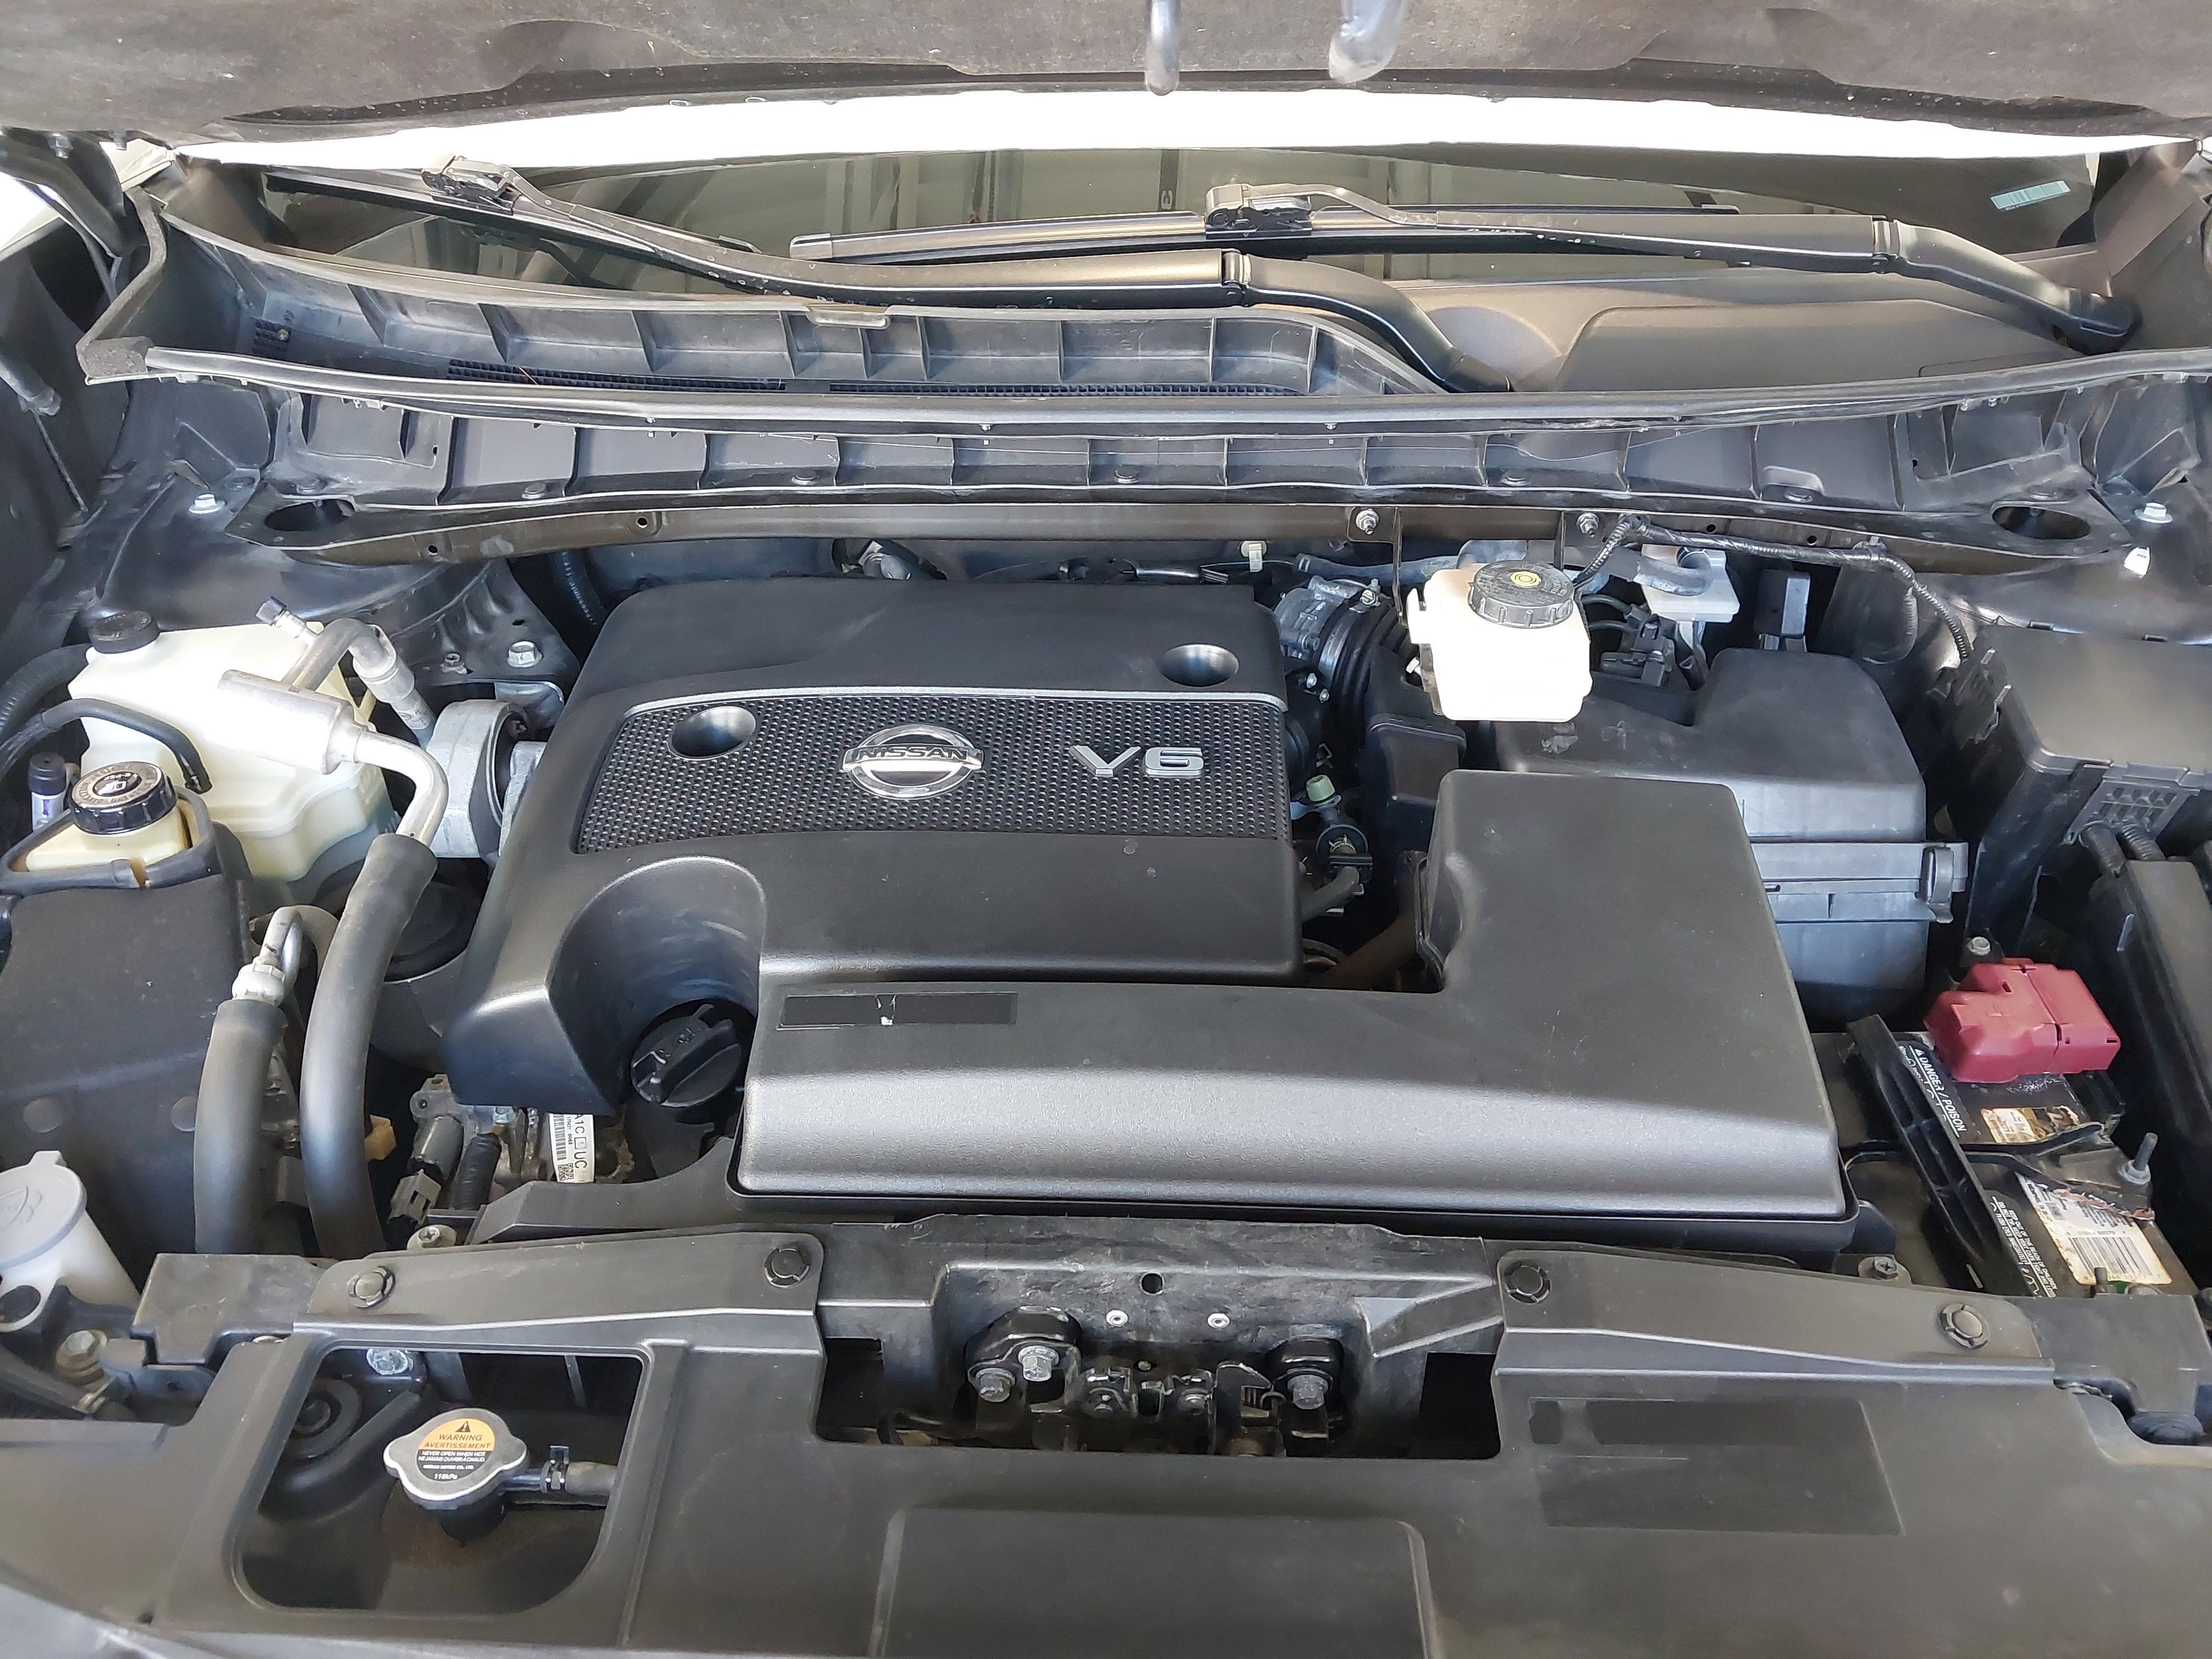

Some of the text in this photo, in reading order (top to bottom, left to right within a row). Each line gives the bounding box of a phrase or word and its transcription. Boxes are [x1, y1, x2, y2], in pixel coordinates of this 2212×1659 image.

[858, 747, 968, 760] NISSAN
[1069, 745, 1204, 779] V6
[1918, 1058, 1945, 1091] DANGER
[1943, 1099, 1967, 1131] POISON
